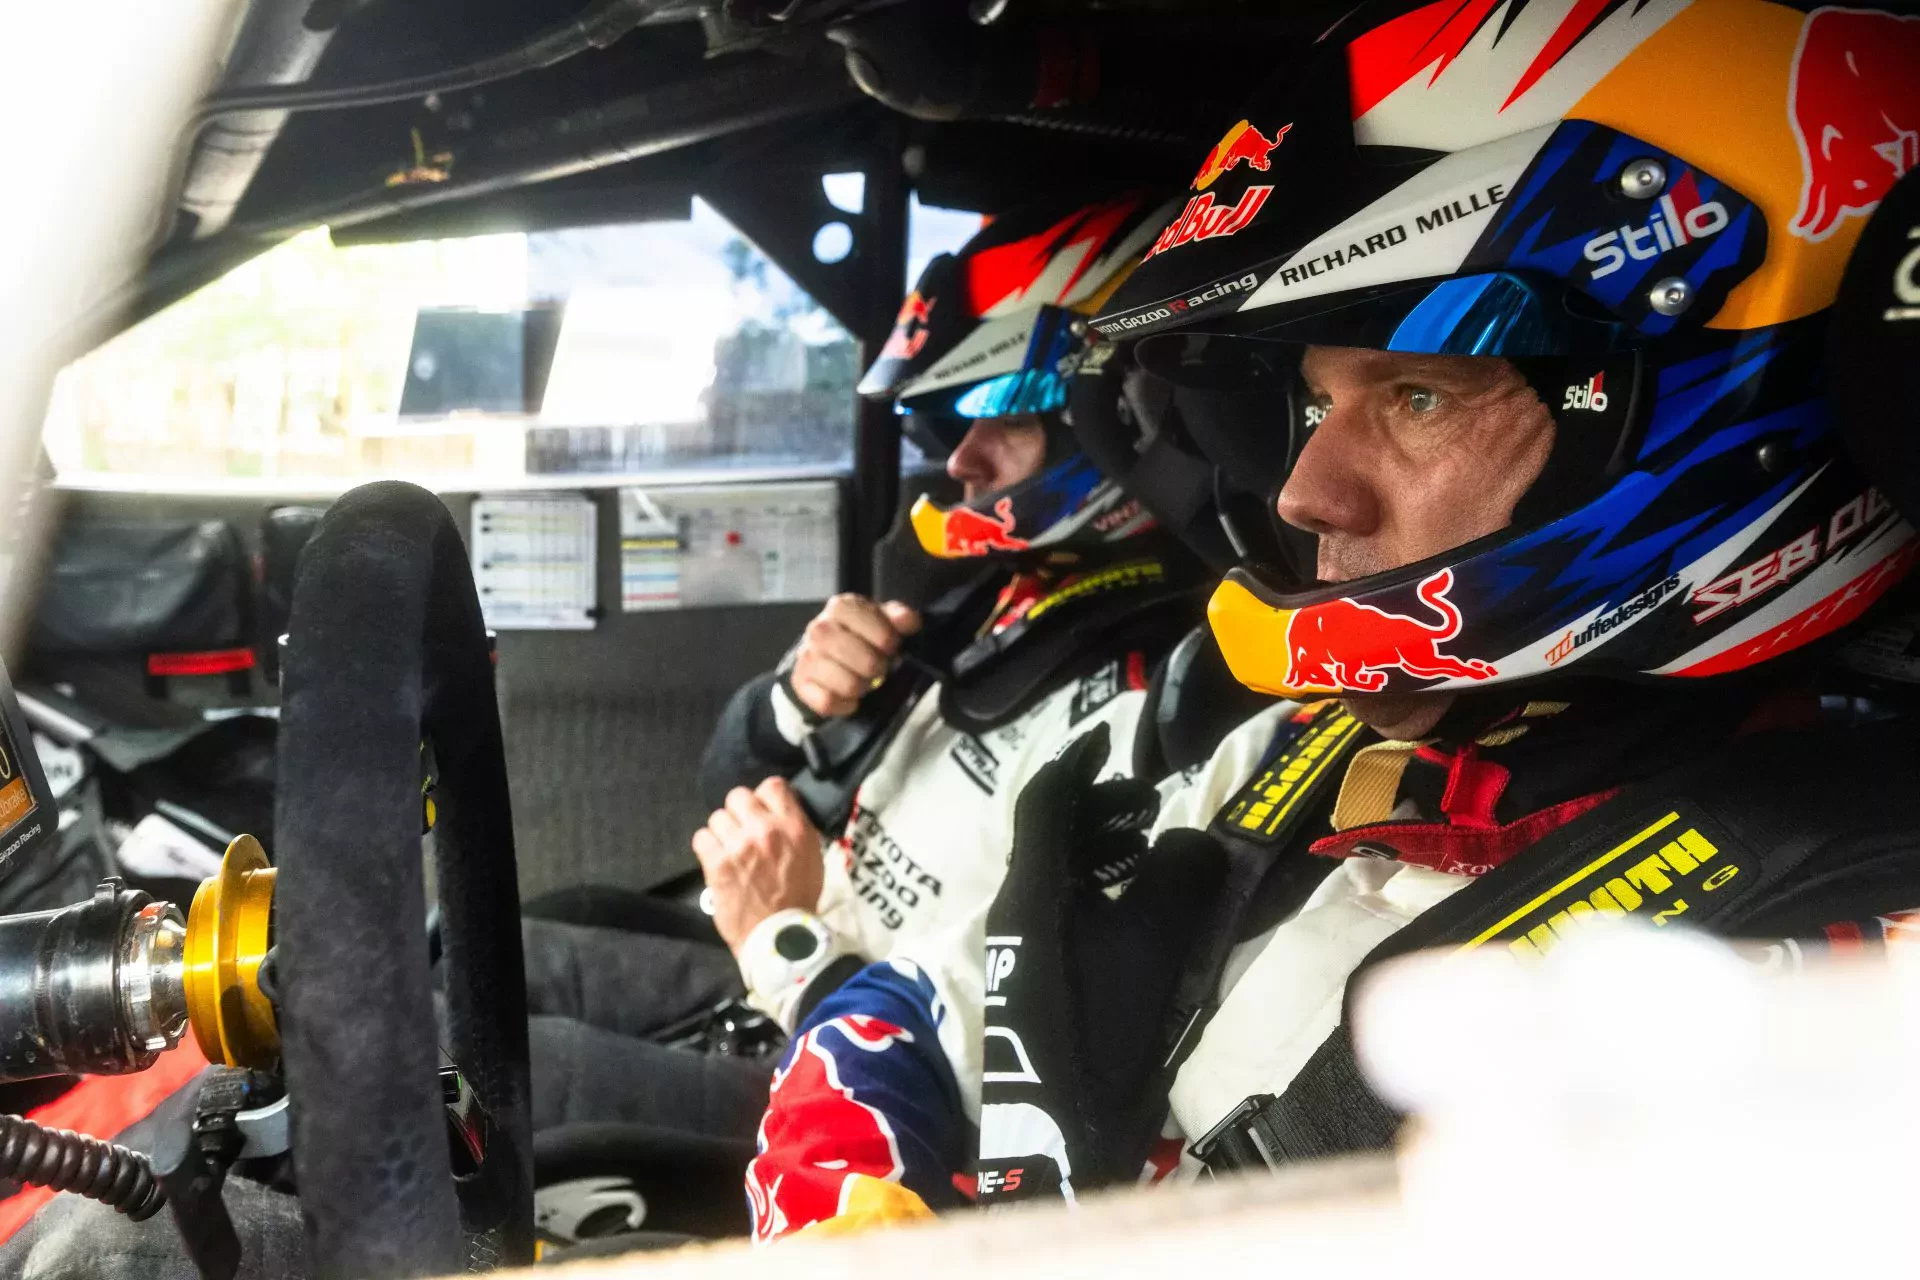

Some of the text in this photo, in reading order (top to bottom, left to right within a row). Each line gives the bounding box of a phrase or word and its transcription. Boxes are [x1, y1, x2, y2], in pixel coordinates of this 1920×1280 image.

[1280, 184, 1504, 286] RICHARD MILLE
[1584, 171, 1729, 280] Stilo
[1121, 308, 1171, 330] GAZOO
[1168, 272, 1259, 315] Racing
[1562, 371, 1608, 412] Stilo
[1691, 525, 1821, 626] SEB
[0, 787, 27, 818] dbrake
[977, 1168, 1024, 1194] NE-S
